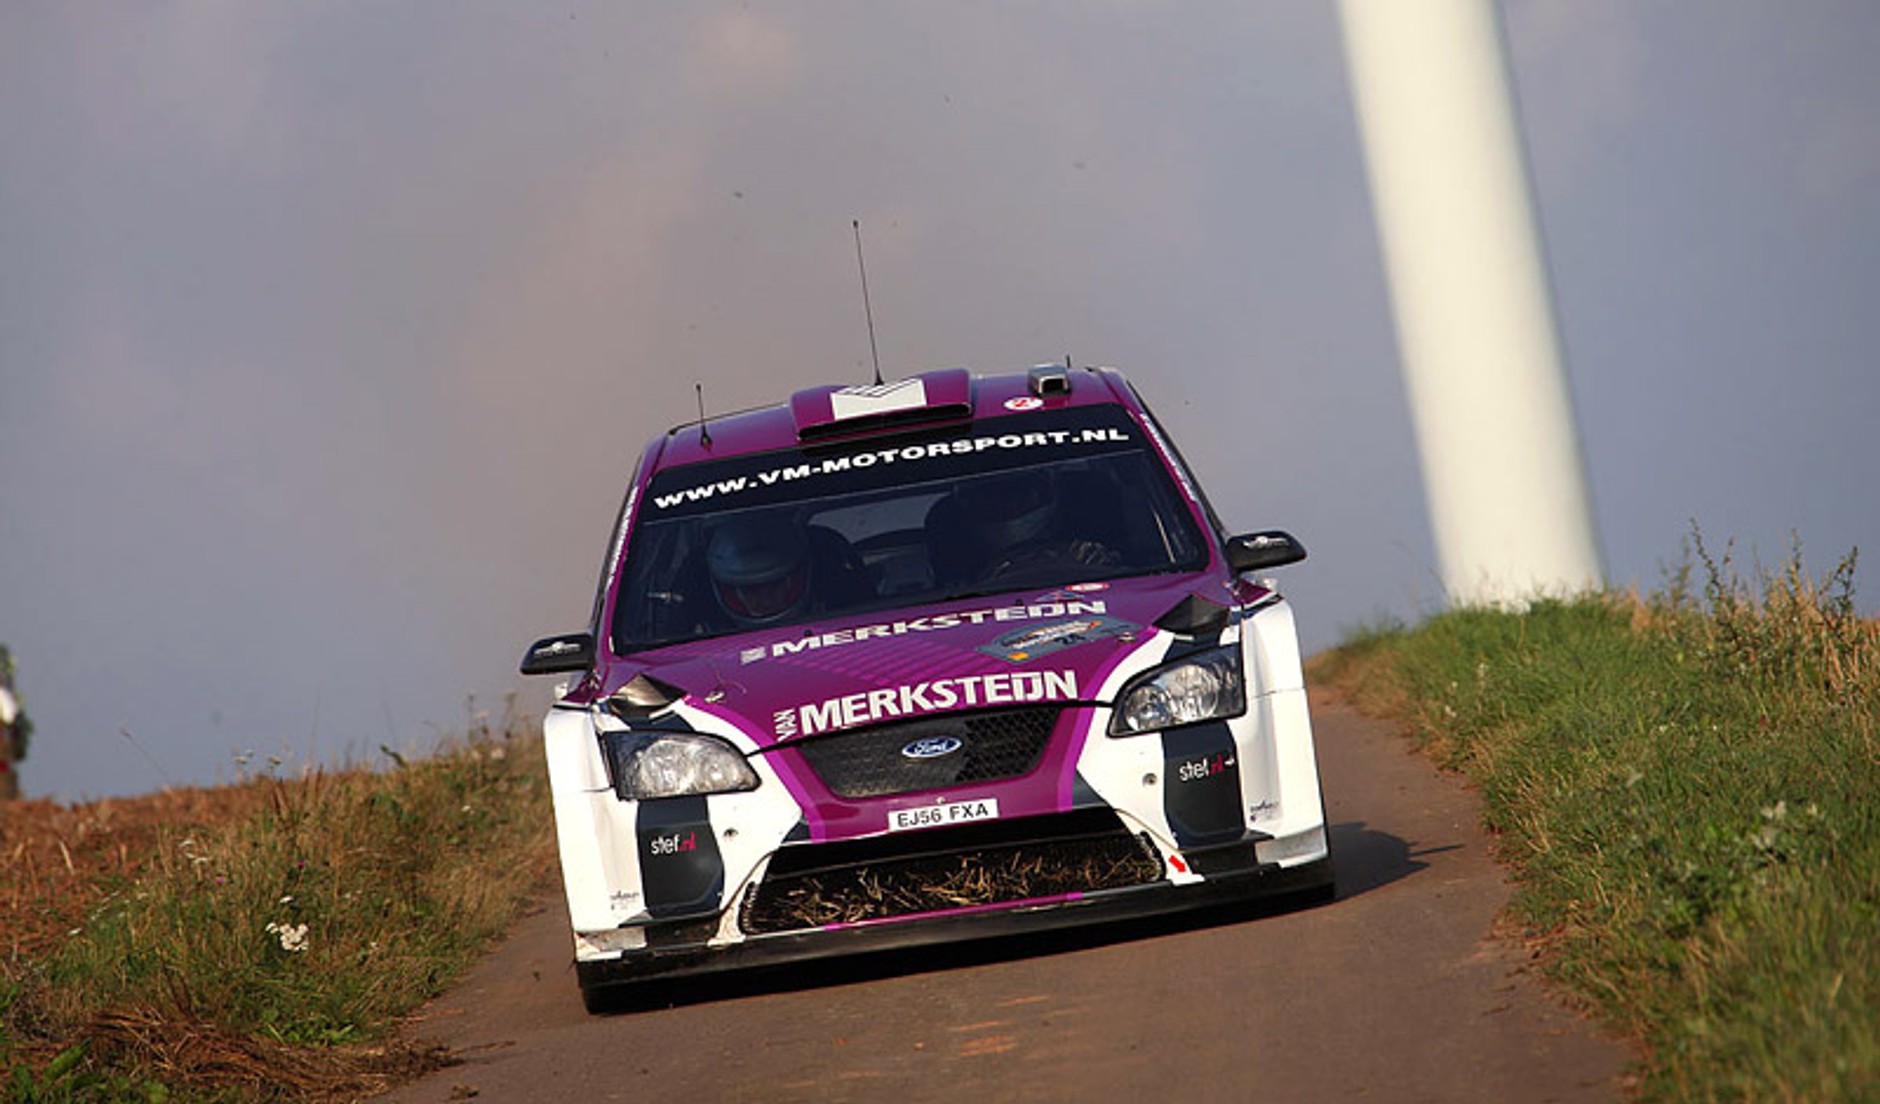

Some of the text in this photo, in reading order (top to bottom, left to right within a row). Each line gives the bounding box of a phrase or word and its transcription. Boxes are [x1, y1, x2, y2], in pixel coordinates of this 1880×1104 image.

[654, 429, 1129, 509] WWW.VM-MOTORSPORT.NL
[914, 740, 950, 753] Ford
[897, 802, 989, 828] EJ56 FXA
[650, 831, 697, 855] stef.nl
